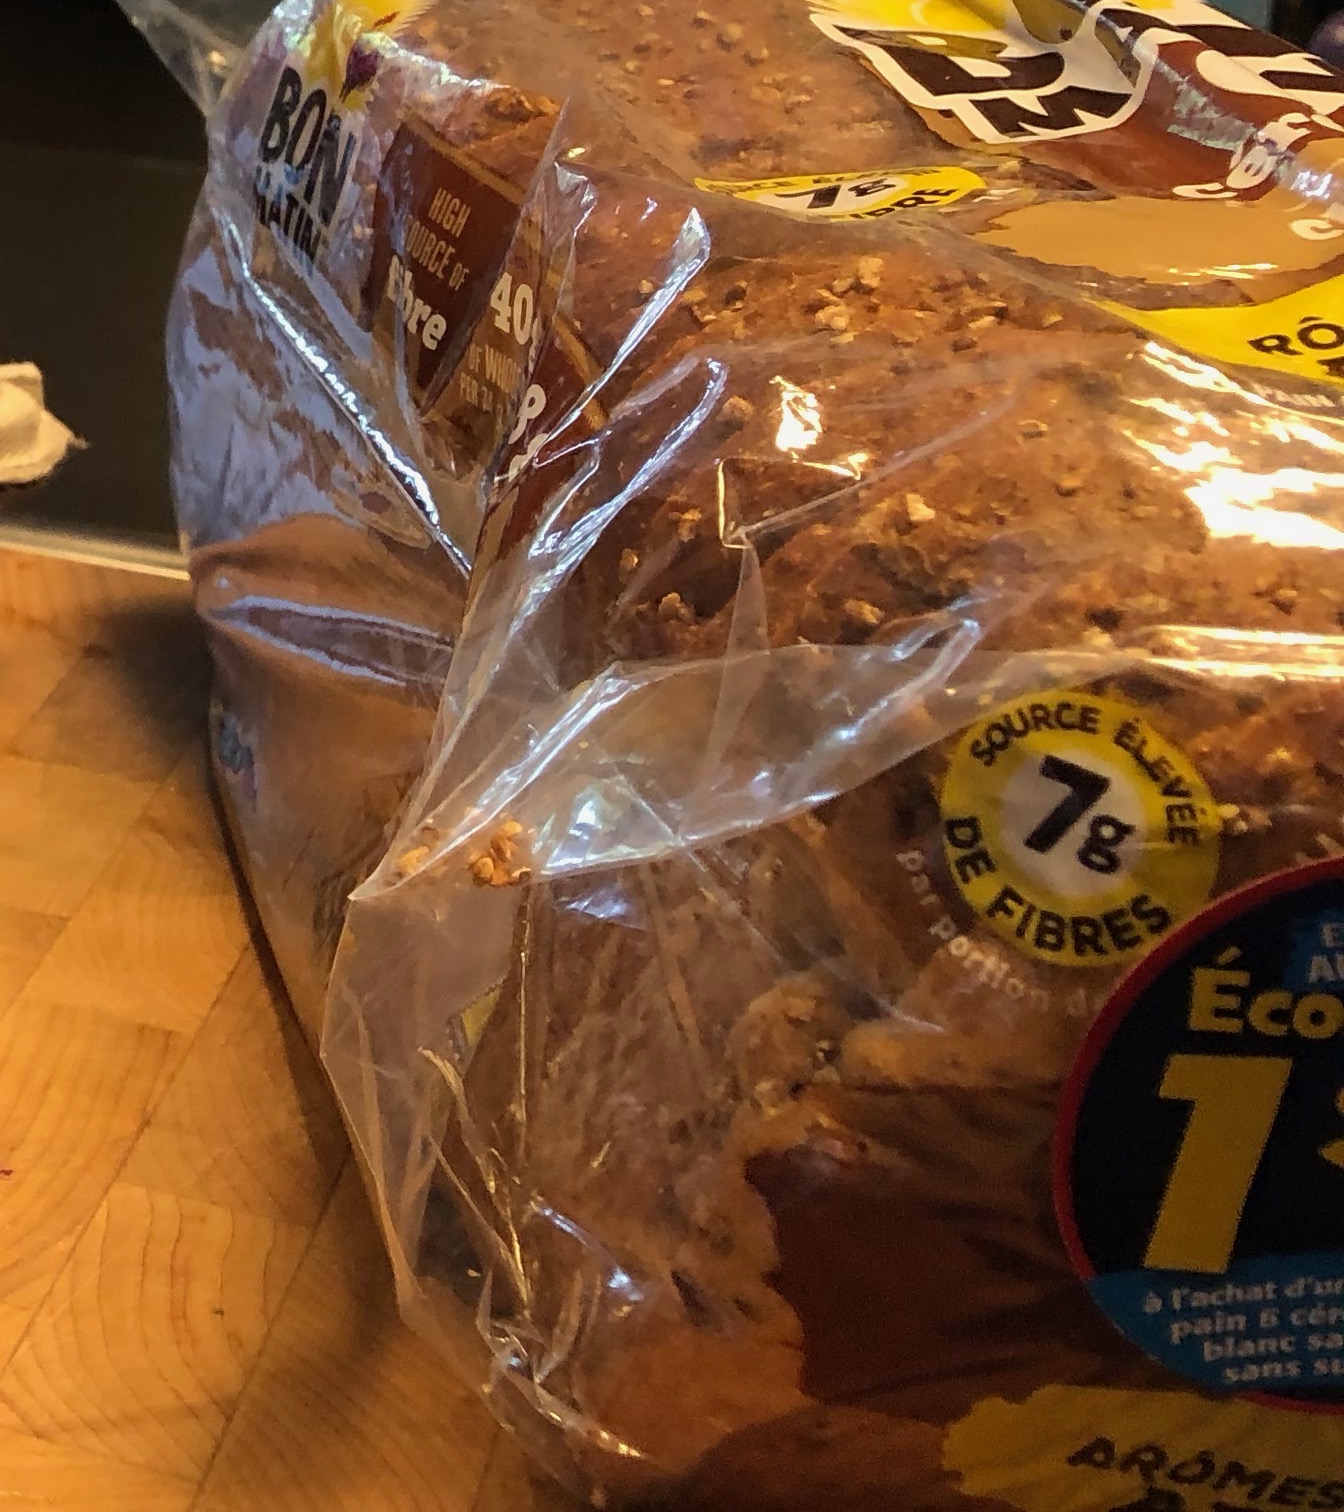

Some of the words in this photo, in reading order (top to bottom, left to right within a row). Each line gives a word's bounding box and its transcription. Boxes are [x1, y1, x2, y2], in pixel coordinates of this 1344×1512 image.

[428, 187, 471, 238] HIGH
[970, 701, 1101, 768] SOURCE
[944, 816, 997, 884] DE
[987, 884, 1174, 956] FIBRES
